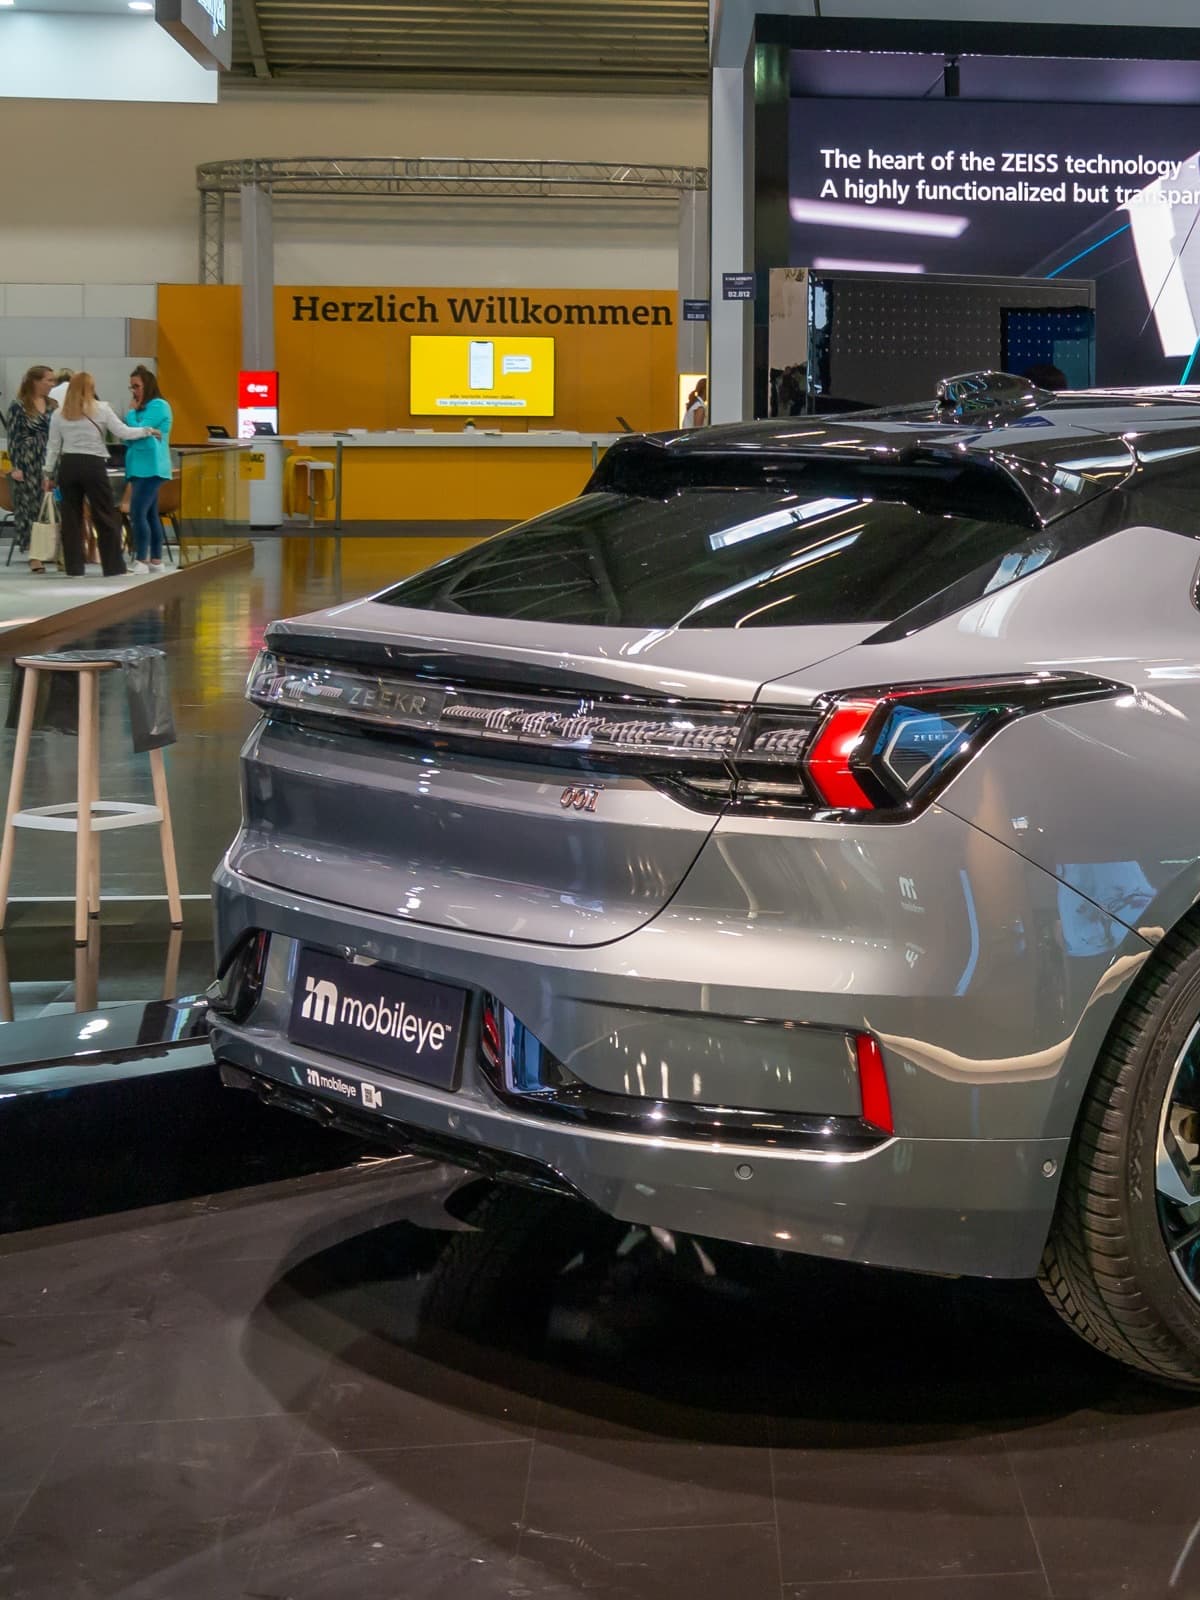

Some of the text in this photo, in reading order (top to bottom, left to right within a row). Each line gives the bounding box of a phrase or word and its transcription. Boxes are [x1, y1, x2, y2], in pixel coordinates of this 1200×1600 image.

[820, 148, 861, 169] The
[868, 149, 925, 170] heart
[931, 151, 954, 171] of
[960, 151, 996, 172] the
[1001, 153, 1059, 173] ZEISS
[1065, 154, 1182, 180] technology
[820, 179, 838, 198] A
[844, 178, 910, 204] highly
[916, 179, 1066, 203] functionalized
[1073, 182, 1109, 203] but
[292, 294, 440, 324] Herzlich
[448, 296, 673, 326] Willkommen
[348, 687, 426, 715] ZEEKR
[320, 1076, 357, 1098] mobileye
